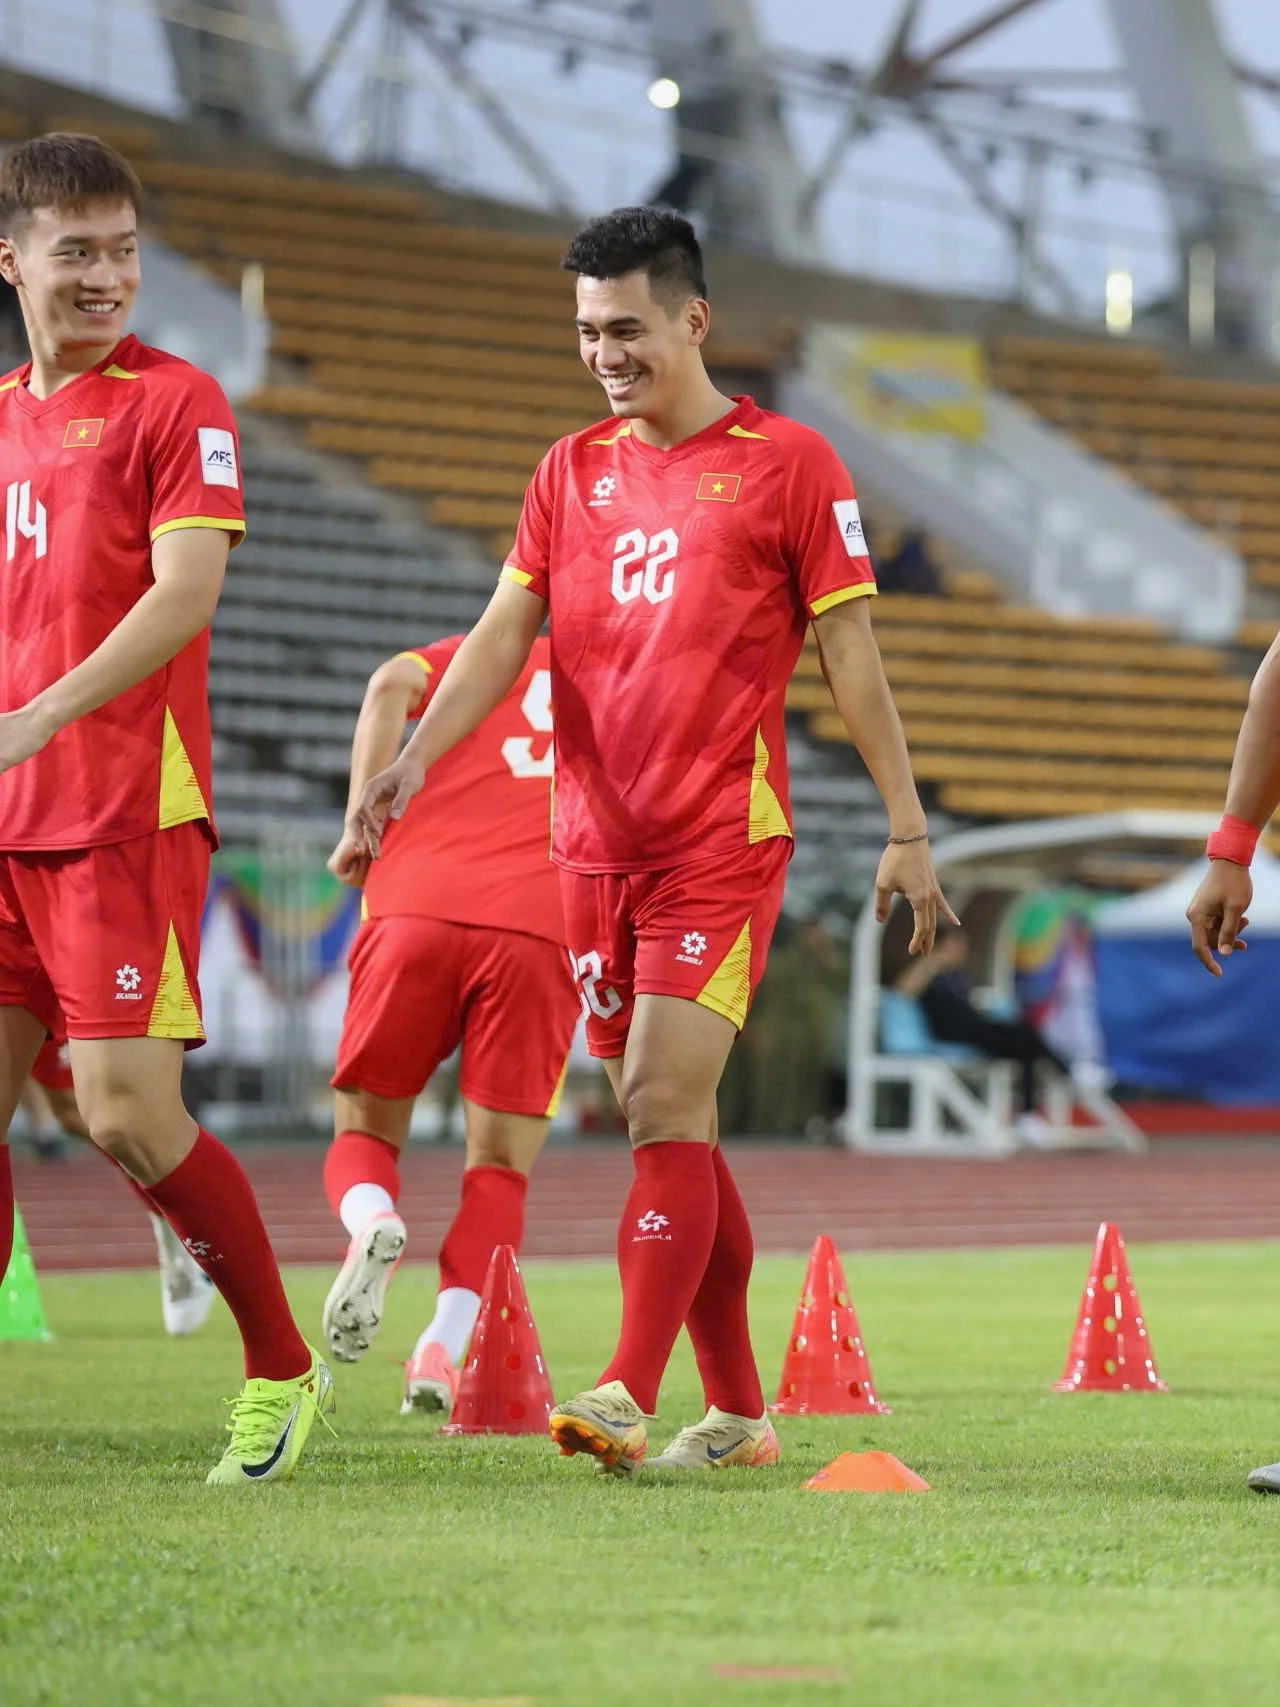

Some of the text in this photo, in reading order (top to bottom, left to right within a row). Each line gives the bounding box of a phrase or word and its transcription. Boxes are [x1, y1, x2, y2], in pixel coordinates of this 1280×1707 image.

[208, 450, 232, 464] AFC
[6, 480, 47, 563] 14
[611, 528, 679, 605] 22
